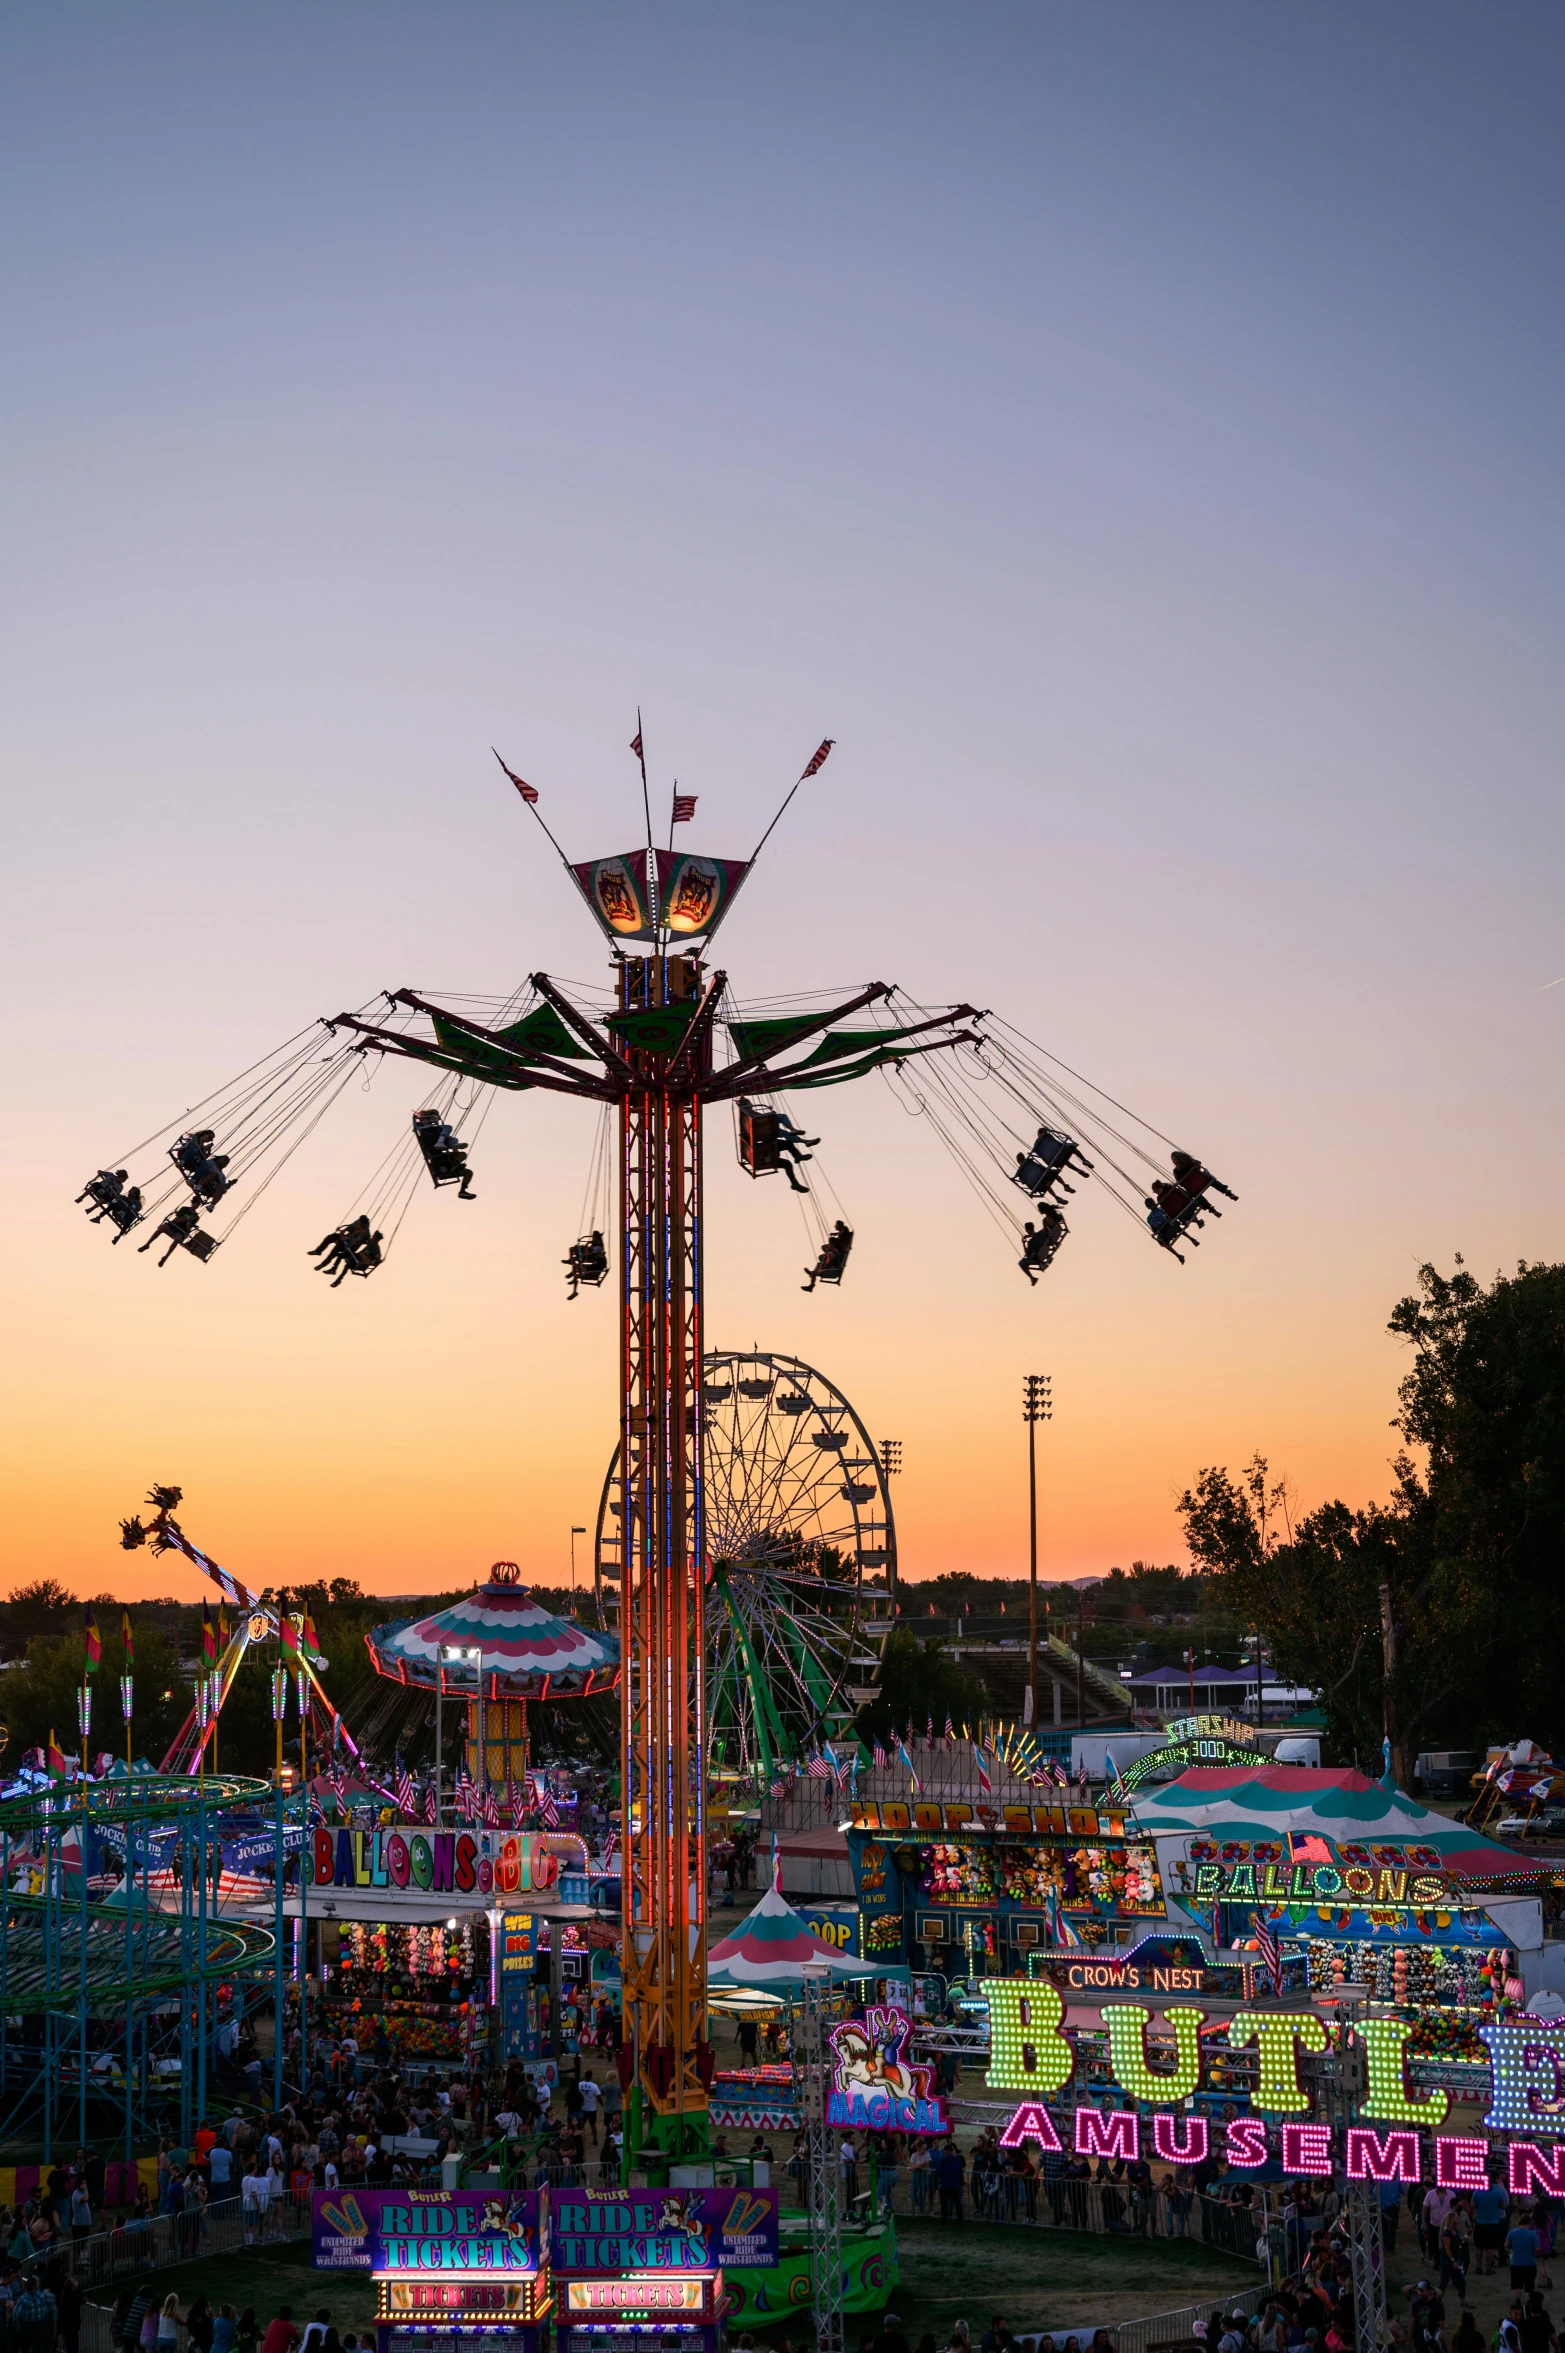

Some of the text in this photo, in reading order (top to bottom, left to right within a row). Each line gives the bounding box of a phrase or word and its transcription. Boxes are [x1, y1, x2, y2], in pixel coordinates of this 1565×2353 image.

[1165, 1715, 1255, 1745] STARSHIP
[1192, 1740, 1225, 1758] 3000
[850, 1800, 1132, 1837] HOOP SHOT
[94, 1824, 162, 1857] JOCK CUB
[914, 1832, 978, 1844] ONE IN WINS
[1040, 1835, 1106, 1849] ONE IN WINS
[237, 1842, 277, 1860] JOCKE
[313, 1828, 478, 1893] BALLOONS
[861, 1843, 886, 1868] HOOP
[502, 1833, 549, 1894] BIG
[861, 1871, 886, 1892] SHOT
[1194, 1862, 1446, 1903] BALLOONS
[938, 1891, 989, 1904] ONE IN WINS
[504, 1914, 532, 1932] WIN
[808, 1920, 851, 1948] OOP
[506, 1935, 530, 1953] BIG
[502, 1955, 534, 1972] PRIZES
[1068, 1962, 1204, 1992] CROW'S NEST
[740, 2009, 776, 2020] GOLDFISH
[979, 1977, 1565, 2136] BUTLE
[827, 2090, 948, 2132] MAGICAL
[999, 2100, 1565, 2198] AMUSEMEN
[407, 2190, 453, 2203] BUTLER
[584, 2188, 630, 2201] BUTLER
[379, 2204, 478, 2236] RIDE
[556, 2202, 656, 2234] RIDE
[321, 2236, 365, 2248] UNLIMITED
[558, 2235, 708, 2268] TICKETS
[723, 2234, 767, 2246] UNLIMITED
[735, 2245, 756, 2255] RIDE
[316, 2254, 372, 2267] WRISTBANDS
[381, 2237, 530, 2270] TICKETS
[718, 2253, 774, 2265] WRISTBANDS
[409, 2285, 505, 2309] TICKETS
[587, 2283, 684, 2307] TICKETS
